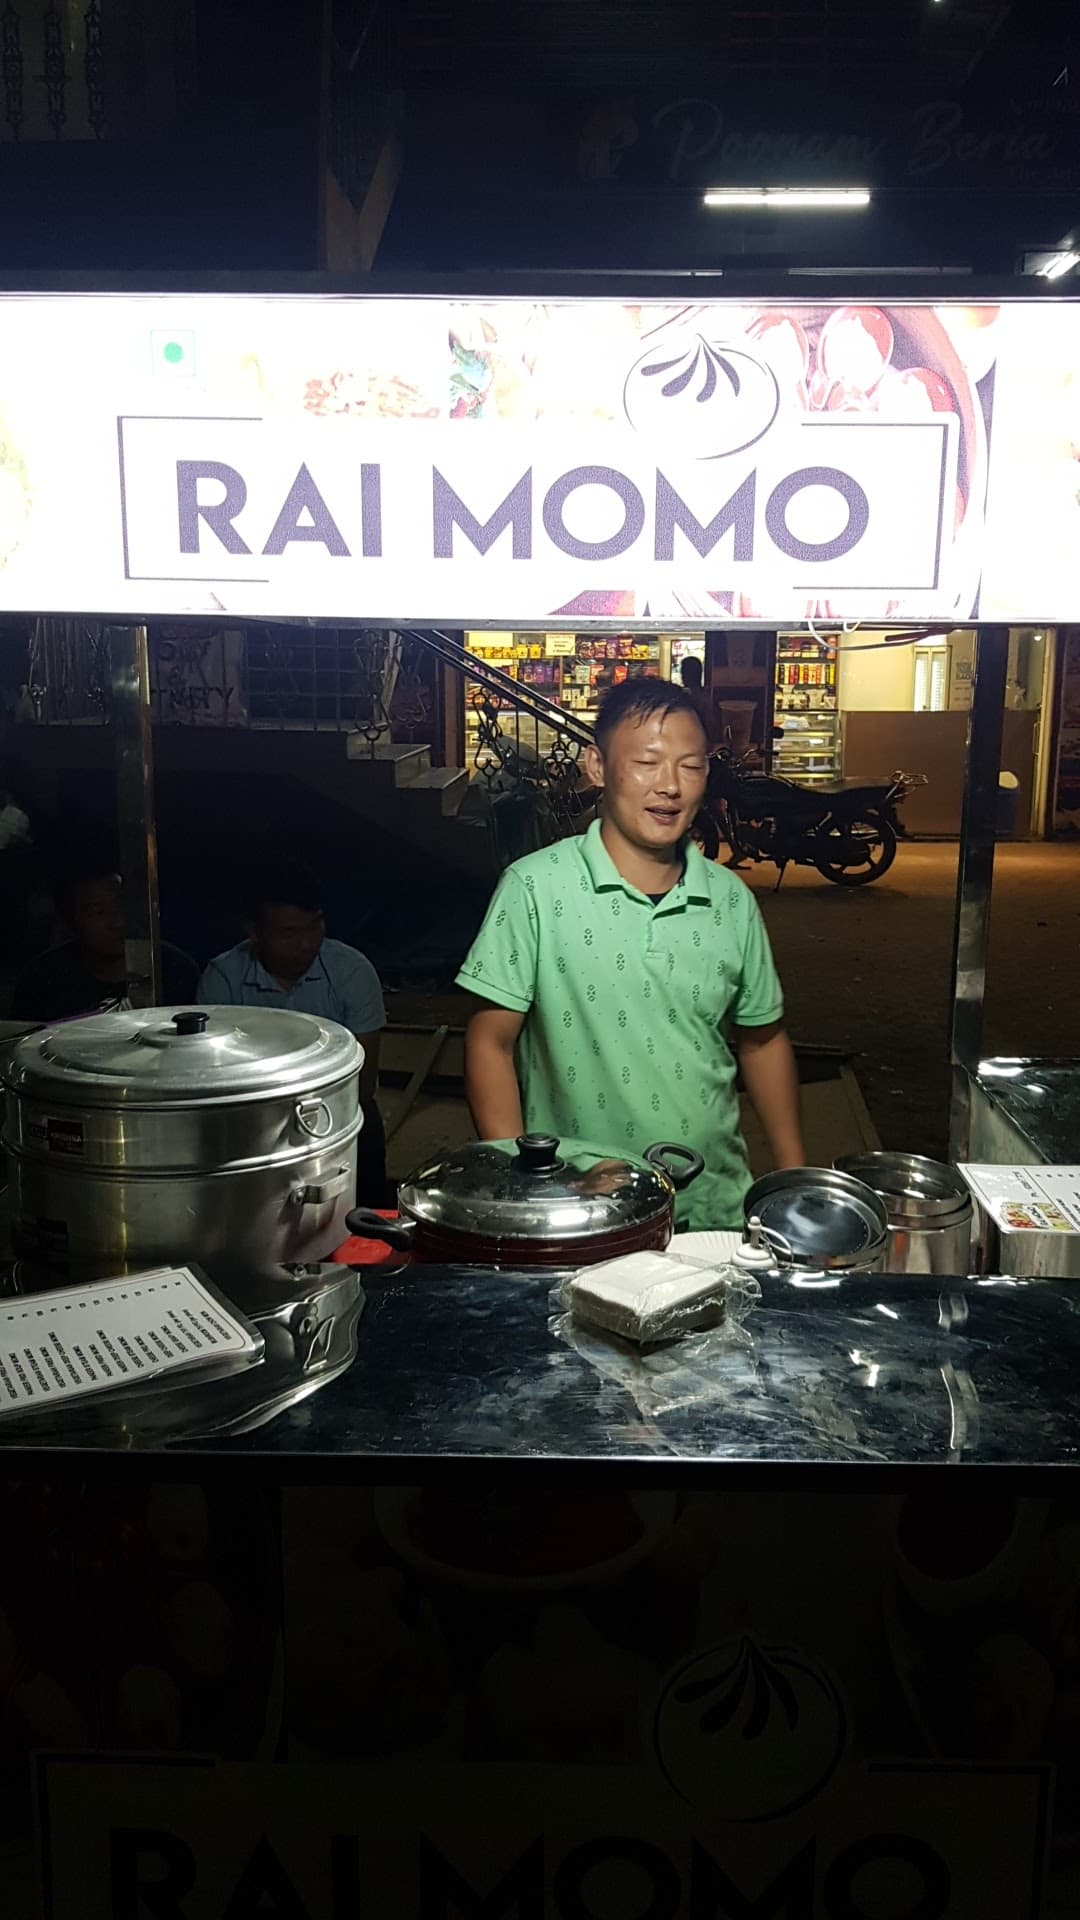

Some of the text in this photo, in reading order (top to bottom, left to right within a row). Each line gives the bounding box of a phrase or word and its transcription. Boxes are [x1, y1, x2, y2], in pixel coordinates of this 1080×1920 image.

[177, 461, 869, 562] RAI MOMO
[107, 1826, 951, 1920] RAI MOMO
